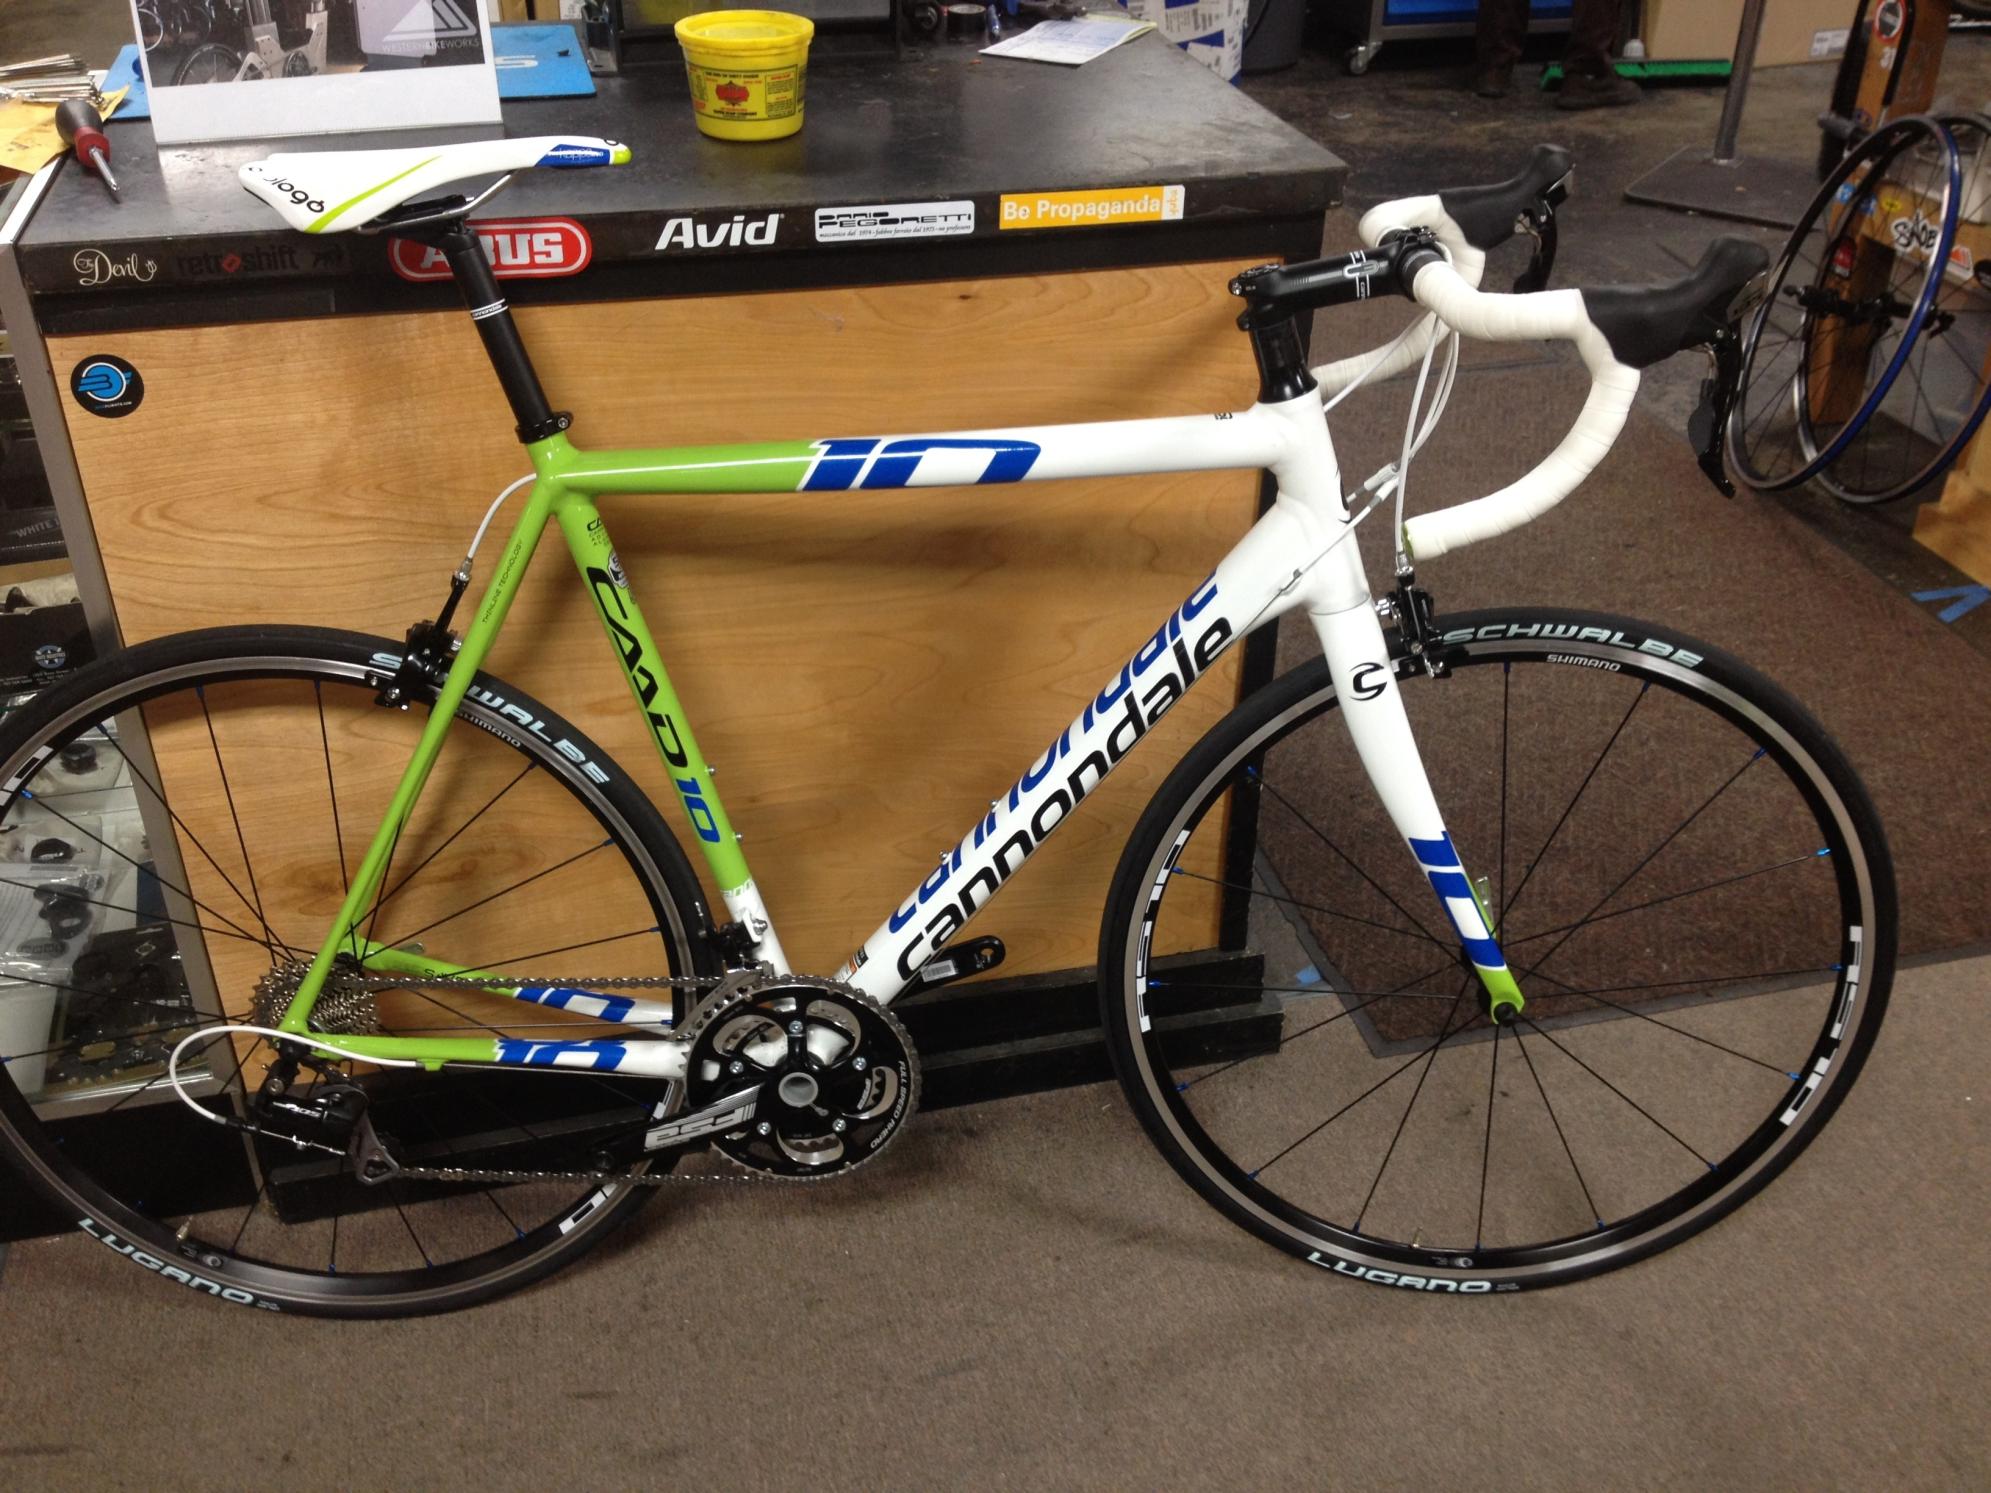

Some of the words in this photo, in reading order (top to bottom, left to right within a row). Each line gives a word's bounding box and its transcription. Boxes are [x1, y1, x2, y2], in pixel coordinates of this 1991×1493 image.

[818, 213, 972, 229] PEGORETTI
[1003, 202, 1030, 220] Be
[1037, 194, 1161, 221] Propaganda
[655, 213, 779, 250] Avid
[1443, 623, 1705, 669] SCHWALBE
[1546, 653, 1622, 673] SHIMANO
[897, 616, 1233, 982] cannondale
[77, 1217, 255, 1305] LUGANO
[1306, 1250, 1493, 1293] LUGANO
